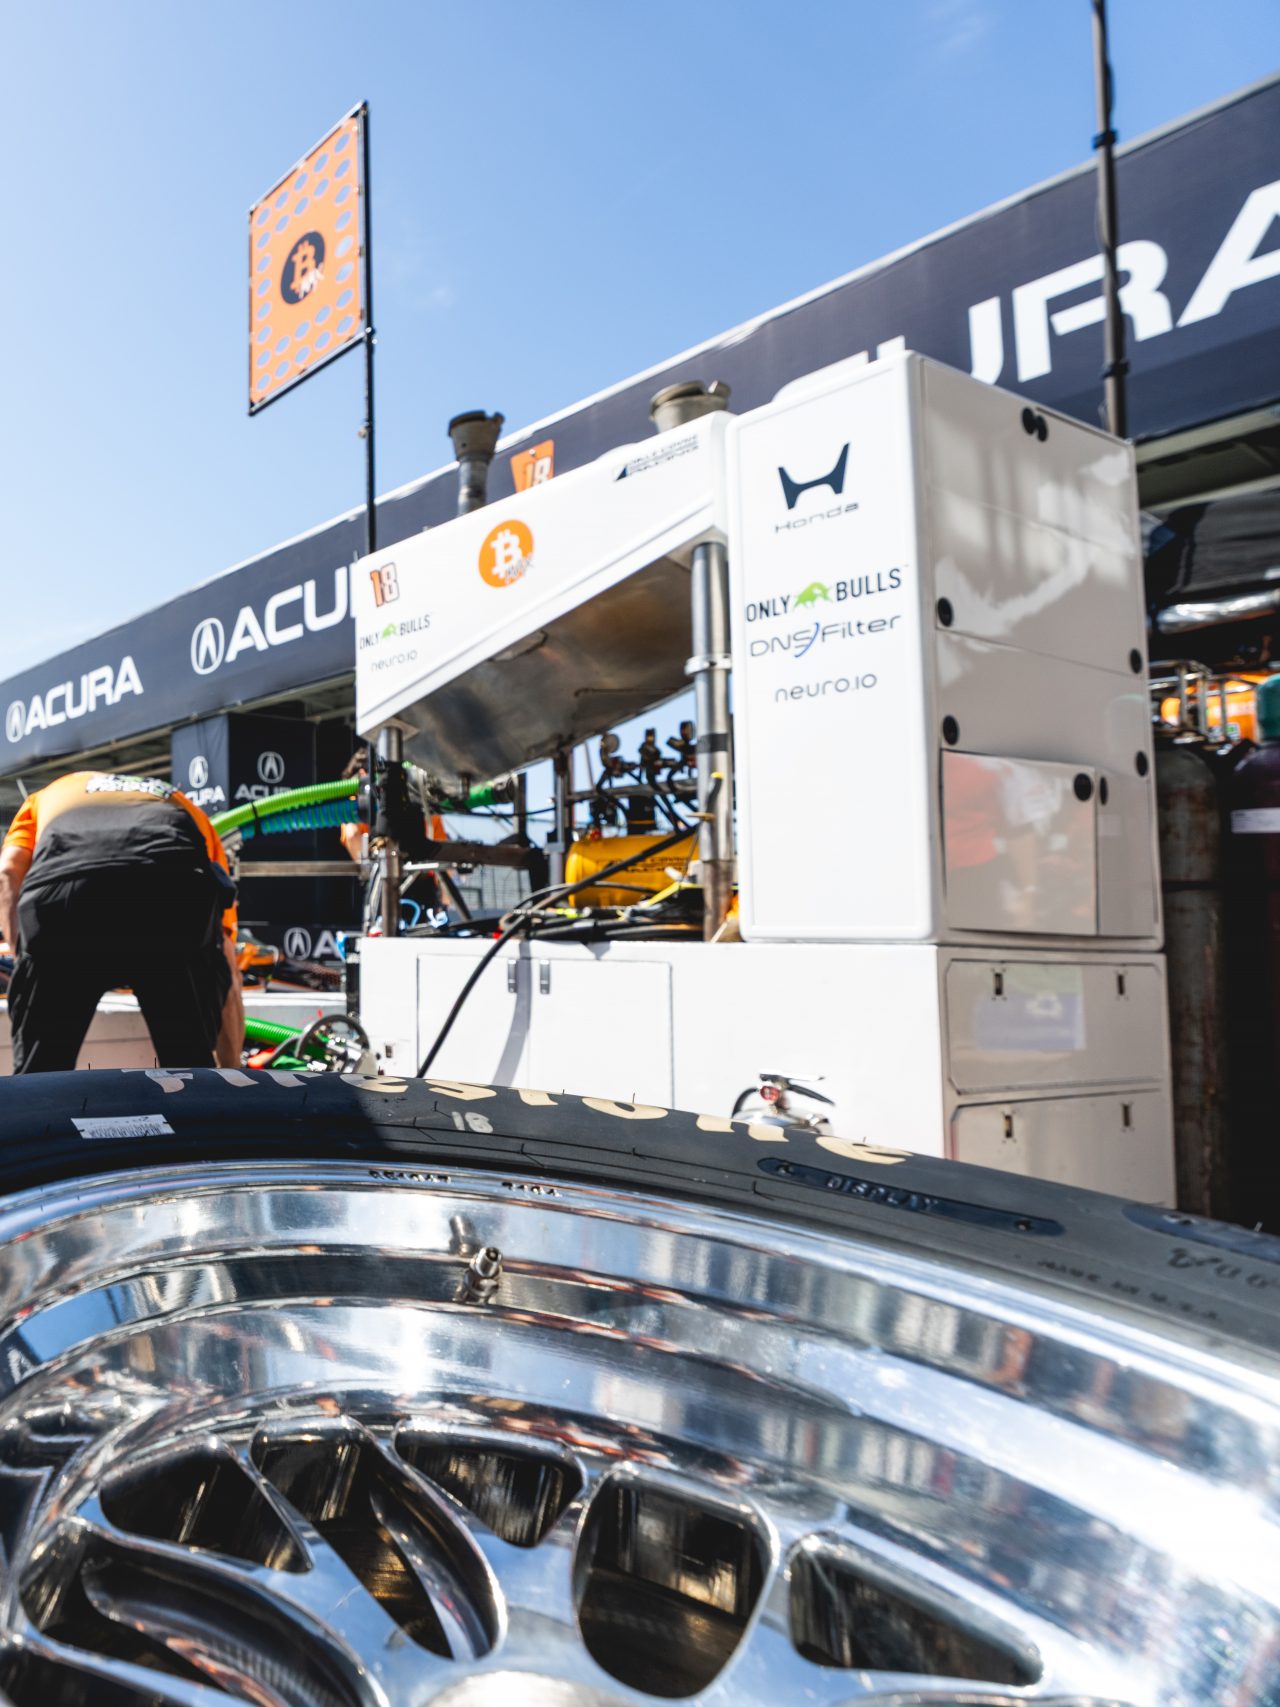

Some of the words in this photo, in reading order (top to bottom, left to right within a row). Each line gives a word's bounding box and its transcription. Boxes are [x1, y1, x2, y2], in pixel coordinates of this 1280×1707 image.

[775, 502, 859, 534] Honda
[369, 561, 400, 608] 18
[746, 594, 791, 623] ONLY
[836, 568, 902, 602] BULLS
[400, 613, 431, 636] BULLS
[751, 615, 901, 658] DNSFilter
[23, 655, 144, 736] ACURA
